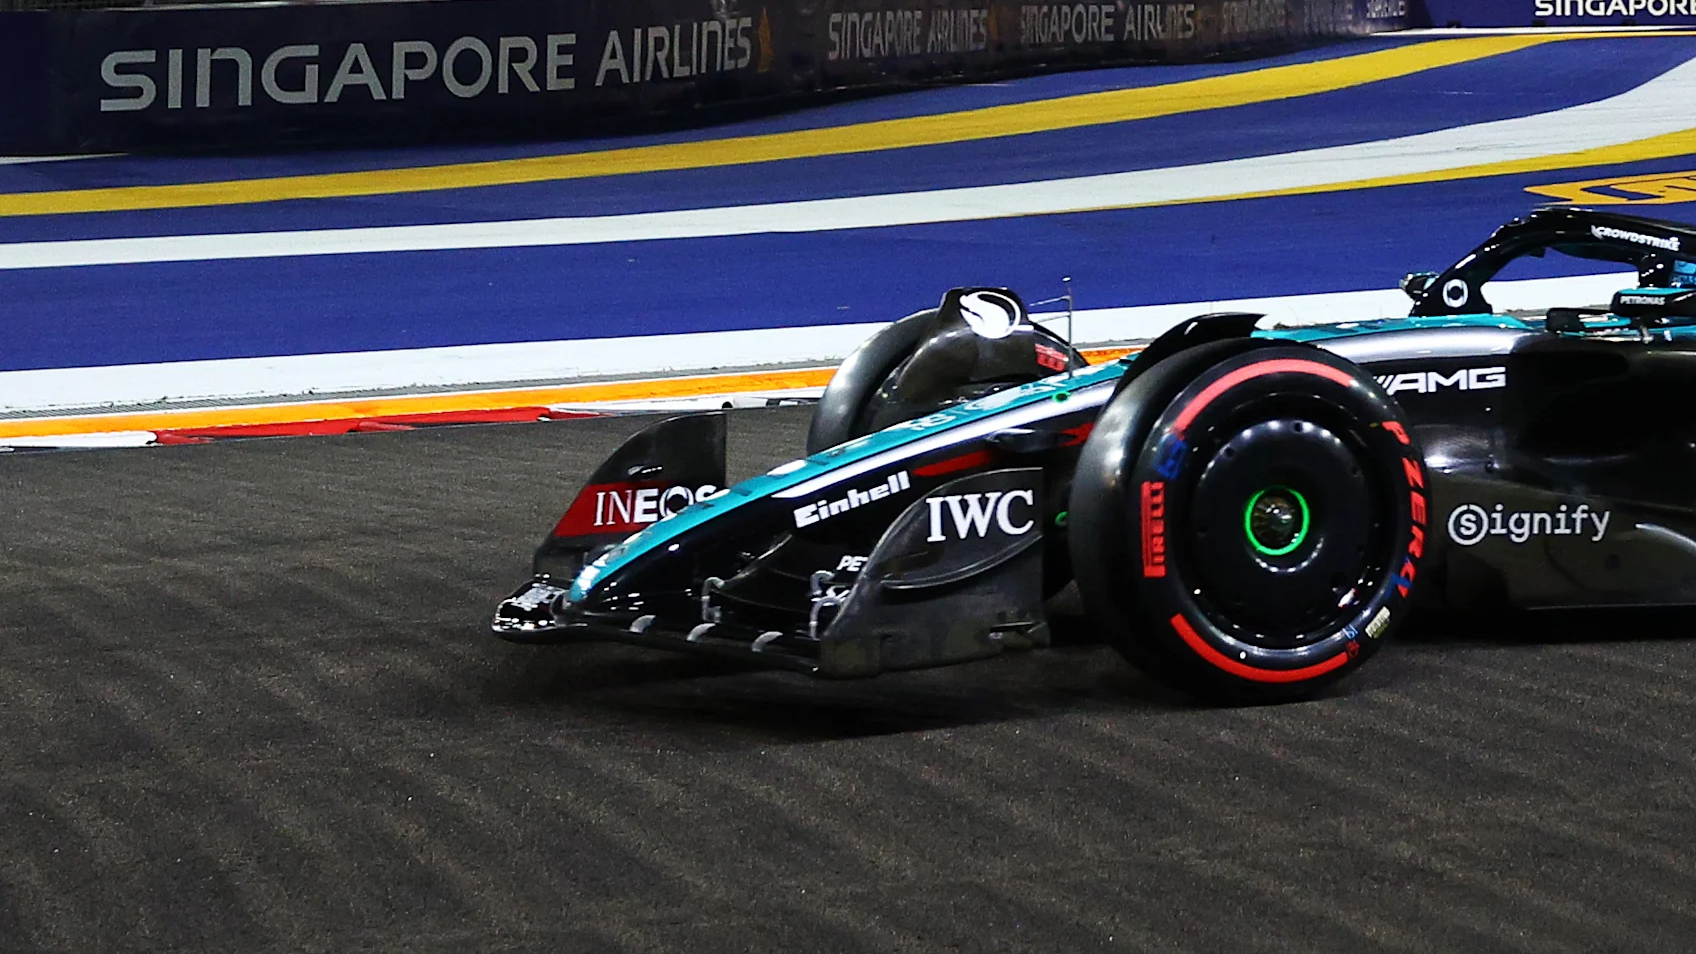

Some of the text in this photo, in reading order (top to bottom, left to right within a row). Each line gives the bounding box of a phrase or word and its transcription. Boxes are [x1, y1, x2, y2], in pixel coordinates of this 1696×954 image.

[828, 9, 922, 62] SINGAPORE
[1020, 2, 1115, 46] SINGAPORE
[1123, 2, 1195, 42] AIRLINES
[100, 15, 752, 112] SINGAPORE AIRLINES
[1596, 226, 1681, 252] CROWDSTRIKE
[1620, 295, 1666, 306] PETRONAS
[793, 470, 911, 528] Einhell
[925, 488, 1035, 543] IWC
[1141, 480, 1167, 578] PIRELLI
